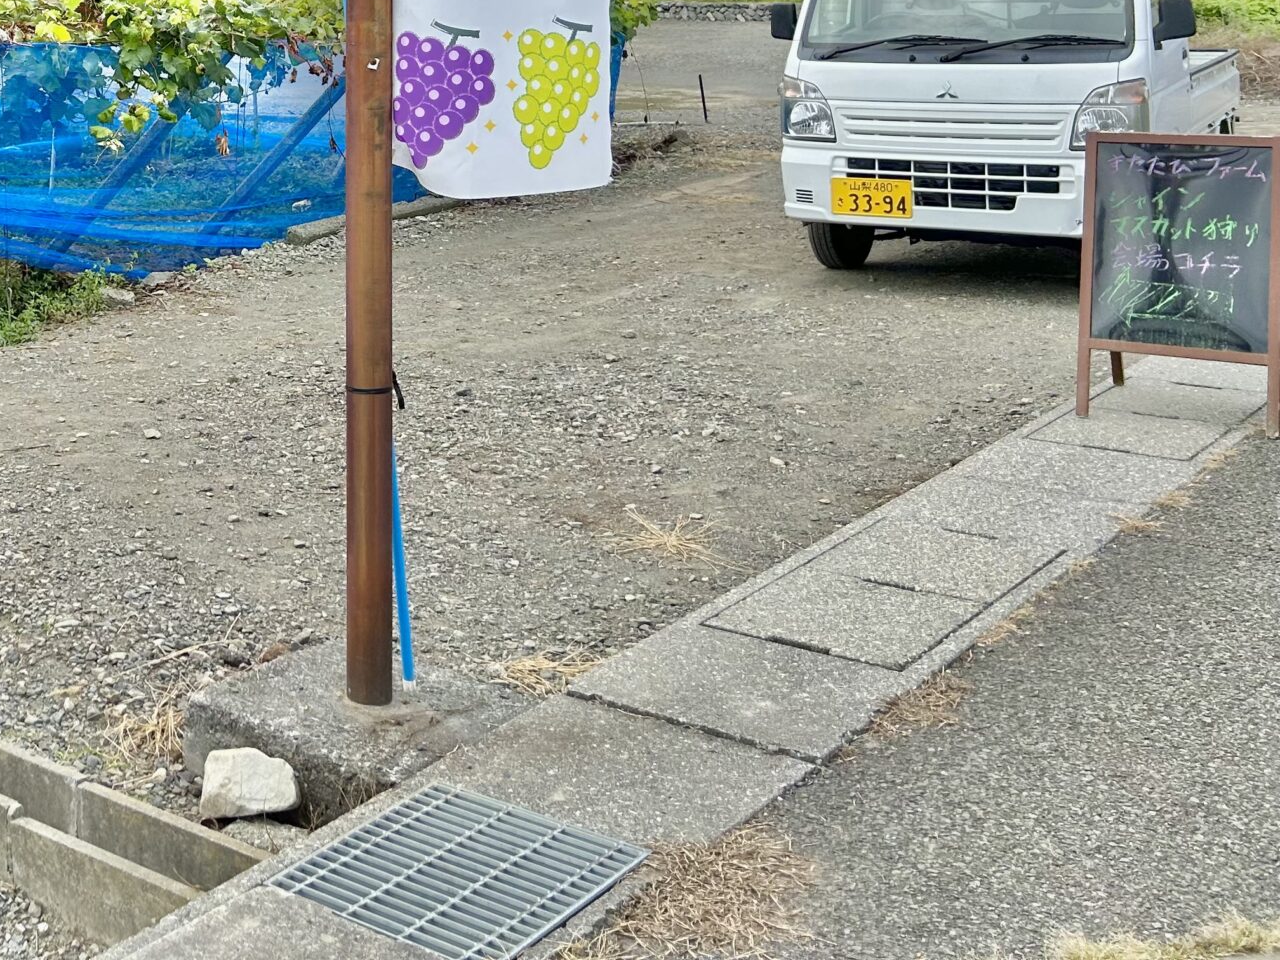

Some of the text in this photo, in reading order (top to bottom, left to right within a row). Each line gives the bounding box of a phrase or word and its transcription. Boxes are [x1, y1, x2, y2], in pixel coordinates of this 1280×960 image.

[848, 193, 907, 214] 33-94
[1109, 186, 1206, 211] シャイン
